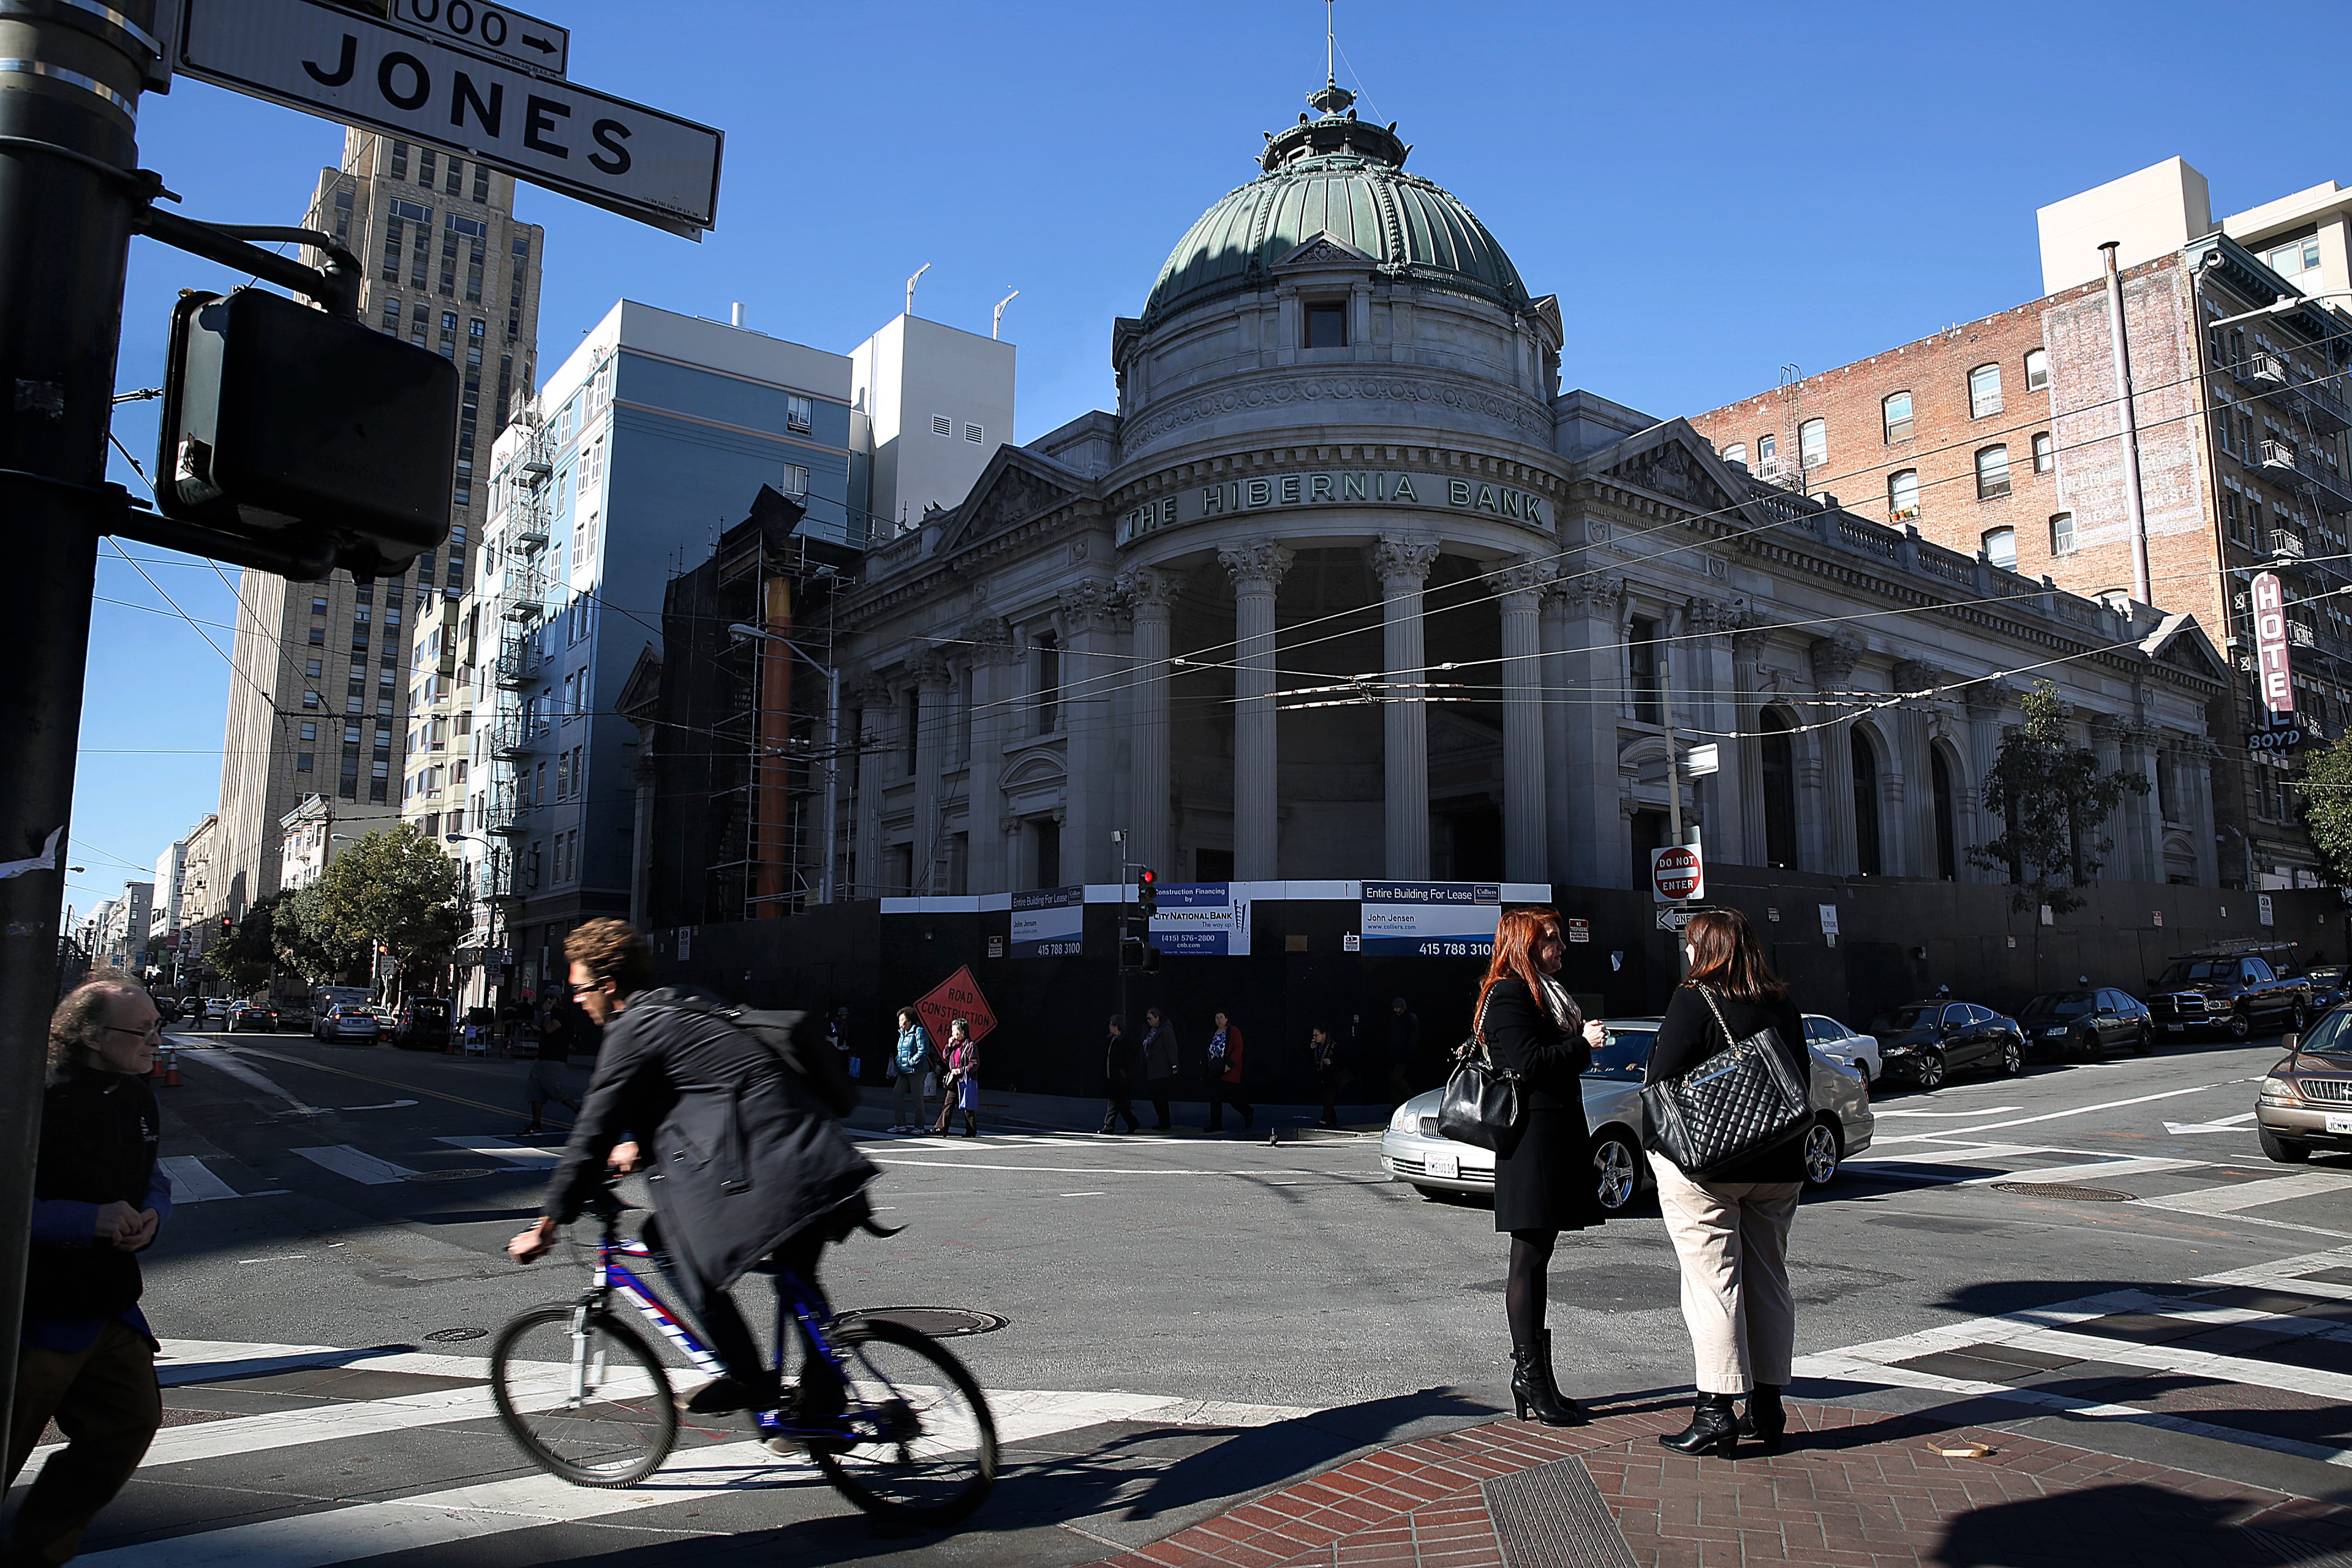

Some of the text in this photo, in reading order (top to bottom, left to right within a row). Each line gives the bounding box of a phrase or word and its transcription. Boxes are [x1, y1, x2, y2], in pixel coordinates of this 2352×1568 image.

[301, 33, 632, 176] JONES
[1126, 473, 1545, 537] THE HIBERNIA BANK
[2258, 581, 2291, 726] HOTEL
[2248, 730, 2301, 750] BOYD
[1659, 856, 1695, 868] DO NOT
[1662, 879, 1694, 891] ENTER
[1013, 897, 1027, 907] Entire
[1027, 895, 1044, 907] Building
[1054, 894, 1068, 903] Lease
[1366, 888, 1392, 899] Entire
[1394, 888, 1428, 900] Building
[1430, 889, 1446, 899] For
[1447, 889, 1472, 900] Lease
[1210, 911, 1232, 920] BANK
[1038, 942, 1080, 956] 415 788 3100
[1419, 943, 1440, 956] 415
[1444, 943, 1466, 956] 788
[948, 987, 973, 1004] ROAD
[921, 1001, 990, 1026] CONSTRUCTION
